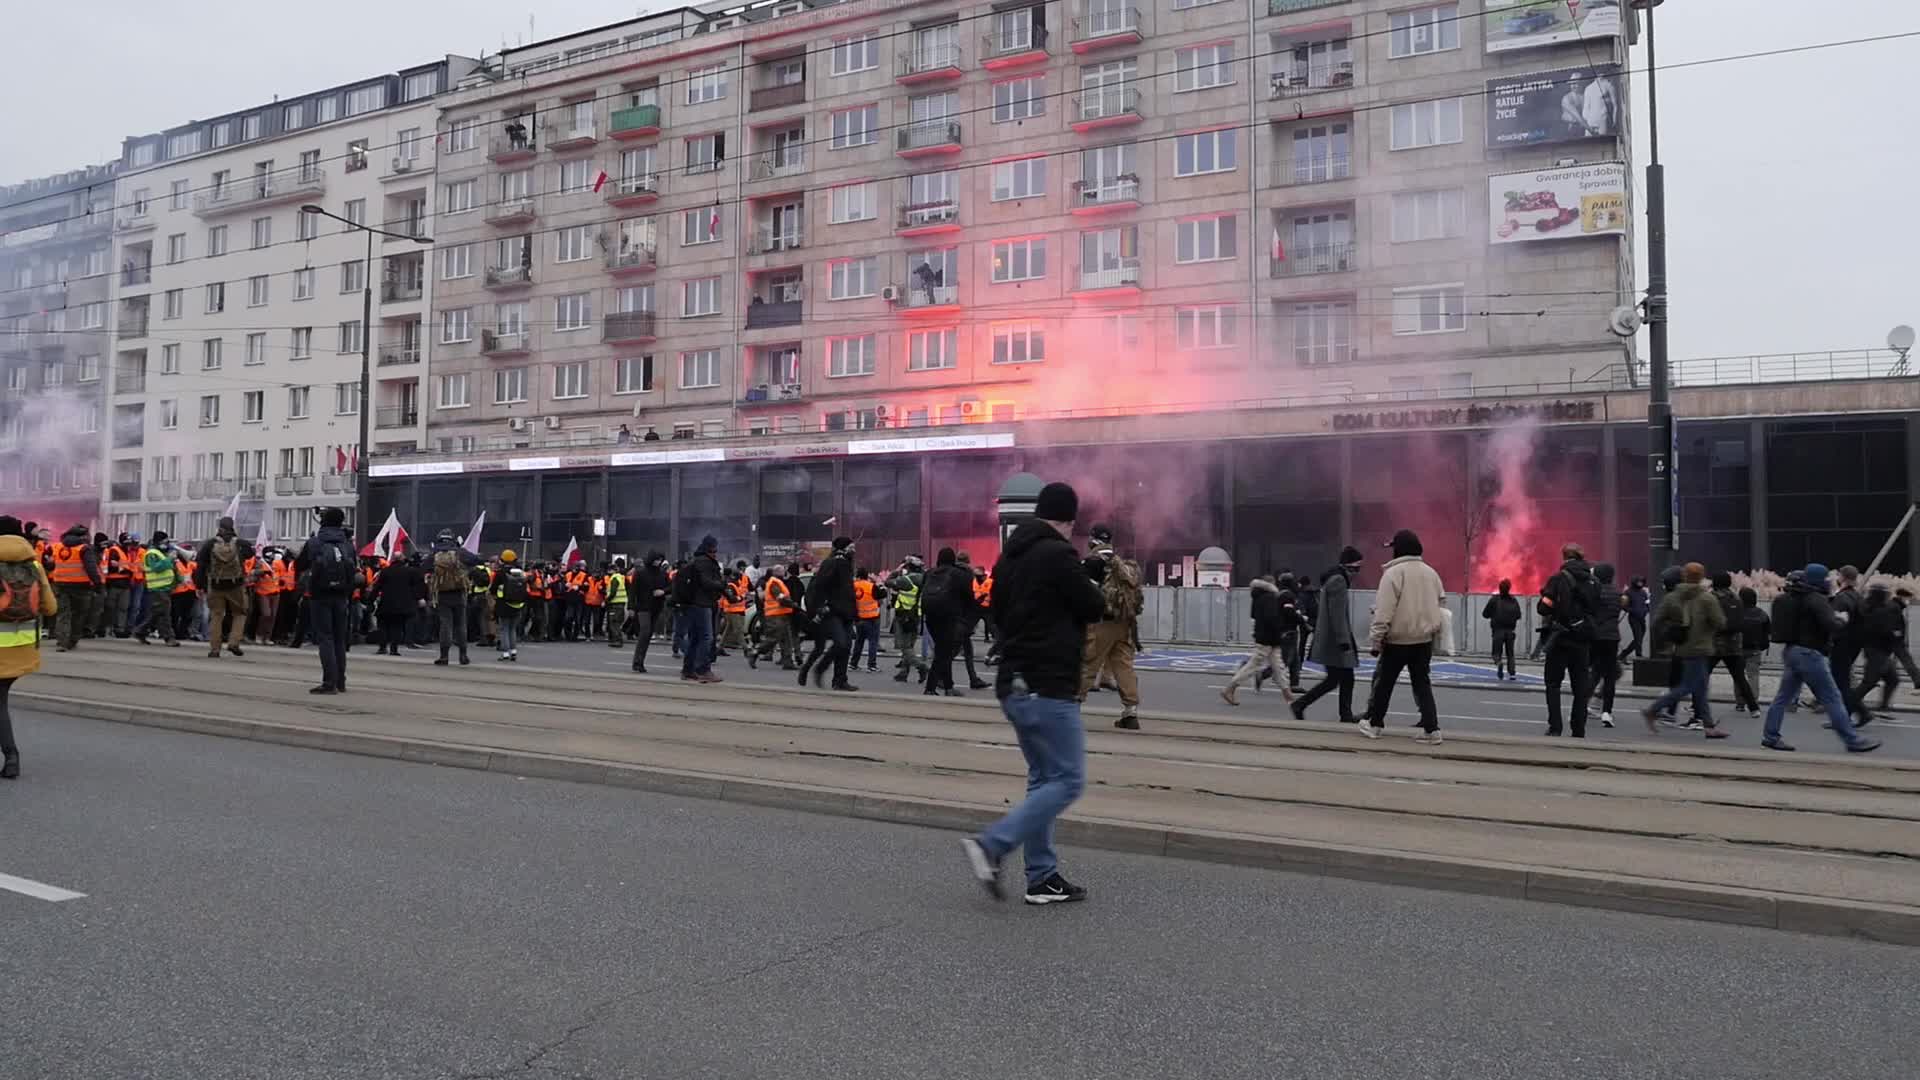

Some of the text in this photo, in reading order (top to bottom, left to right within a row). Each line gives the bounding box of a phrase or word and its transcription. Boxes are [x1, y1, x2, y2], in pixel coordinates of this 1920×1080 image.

[1495, 95, 1525, 108] RATUJE
[1536, 169, 1592, 183] Gwarancja
[1333, 400, 1595, 429] DOM KULTURY ŚRÓDEŚCIE
